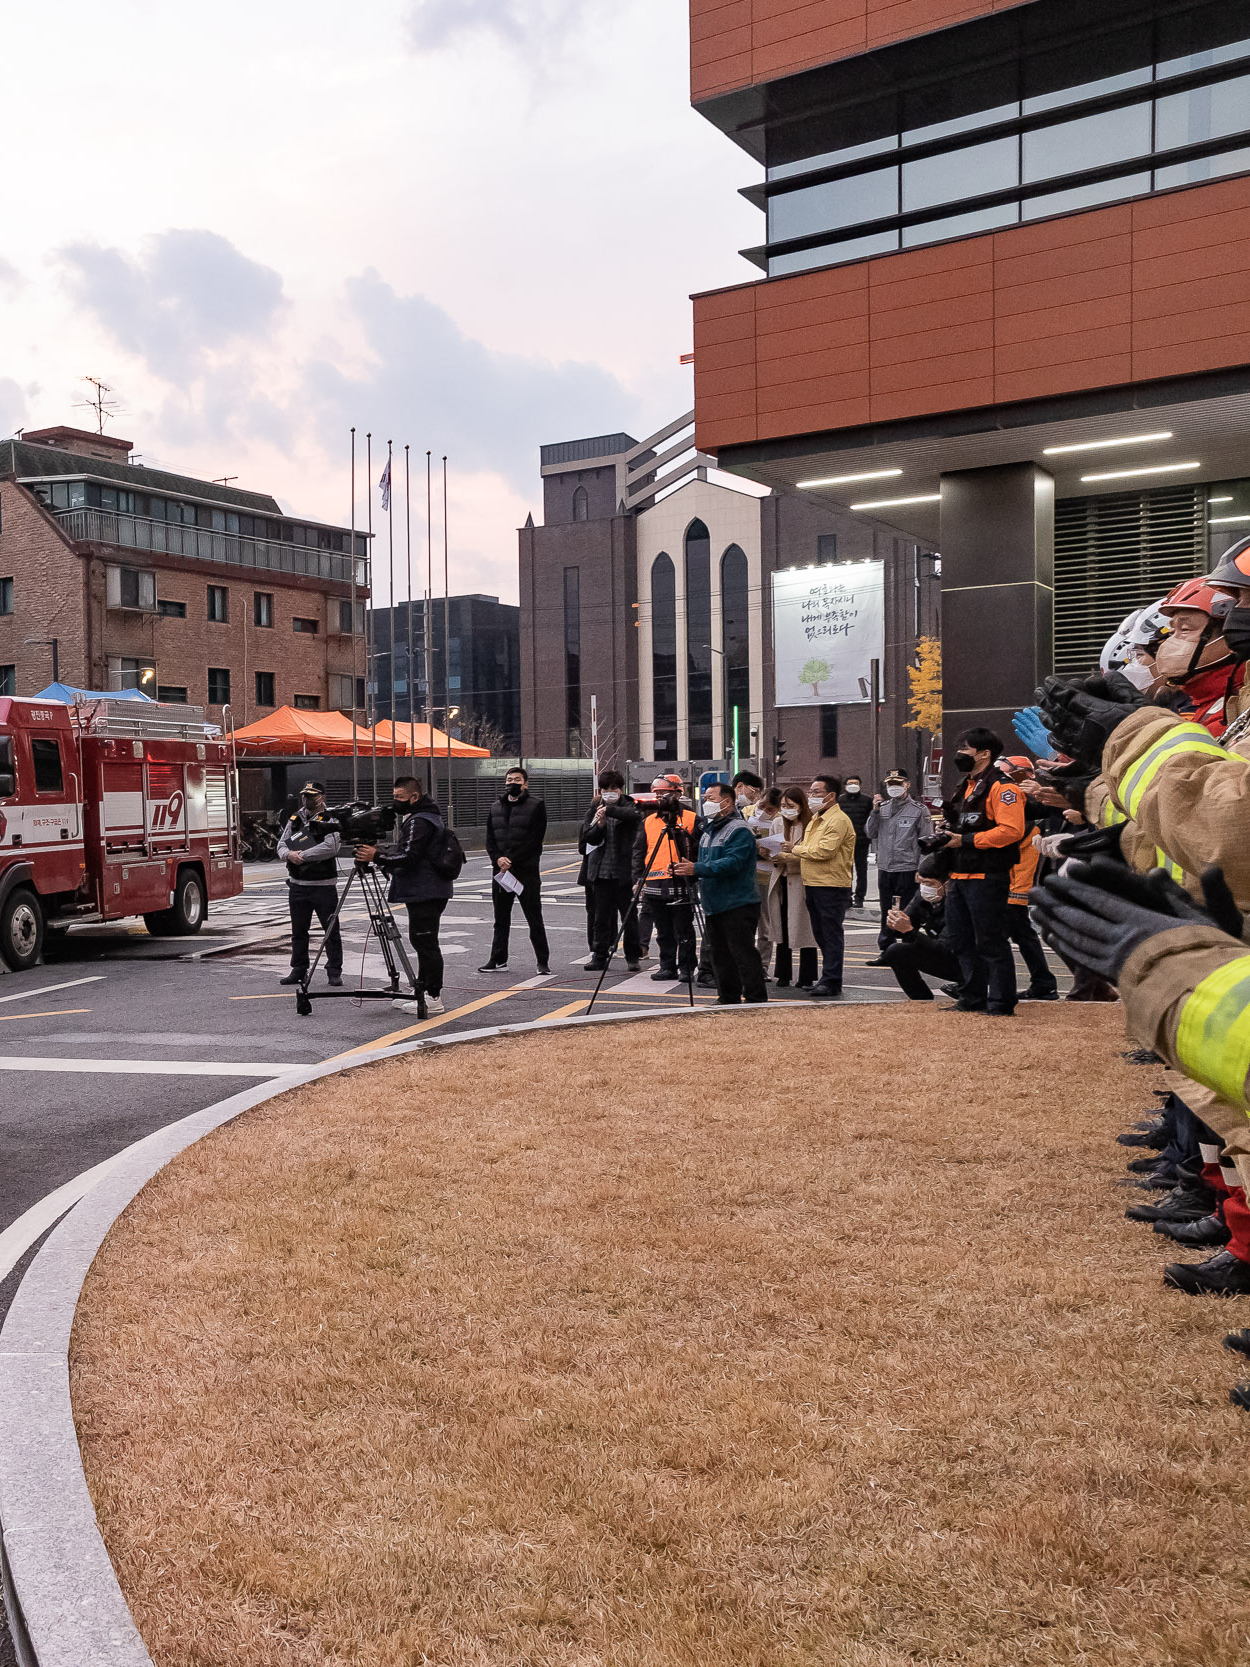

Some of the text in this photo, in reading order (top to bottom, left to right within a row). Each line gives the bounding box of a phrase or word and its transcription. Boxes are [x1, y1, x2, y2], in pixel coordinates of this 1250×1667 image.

[802, 609, 857, 623] 내게 부족함이
[805, 623, 855, 642] 없으리로다
[150, 789, 184, 831] 119
